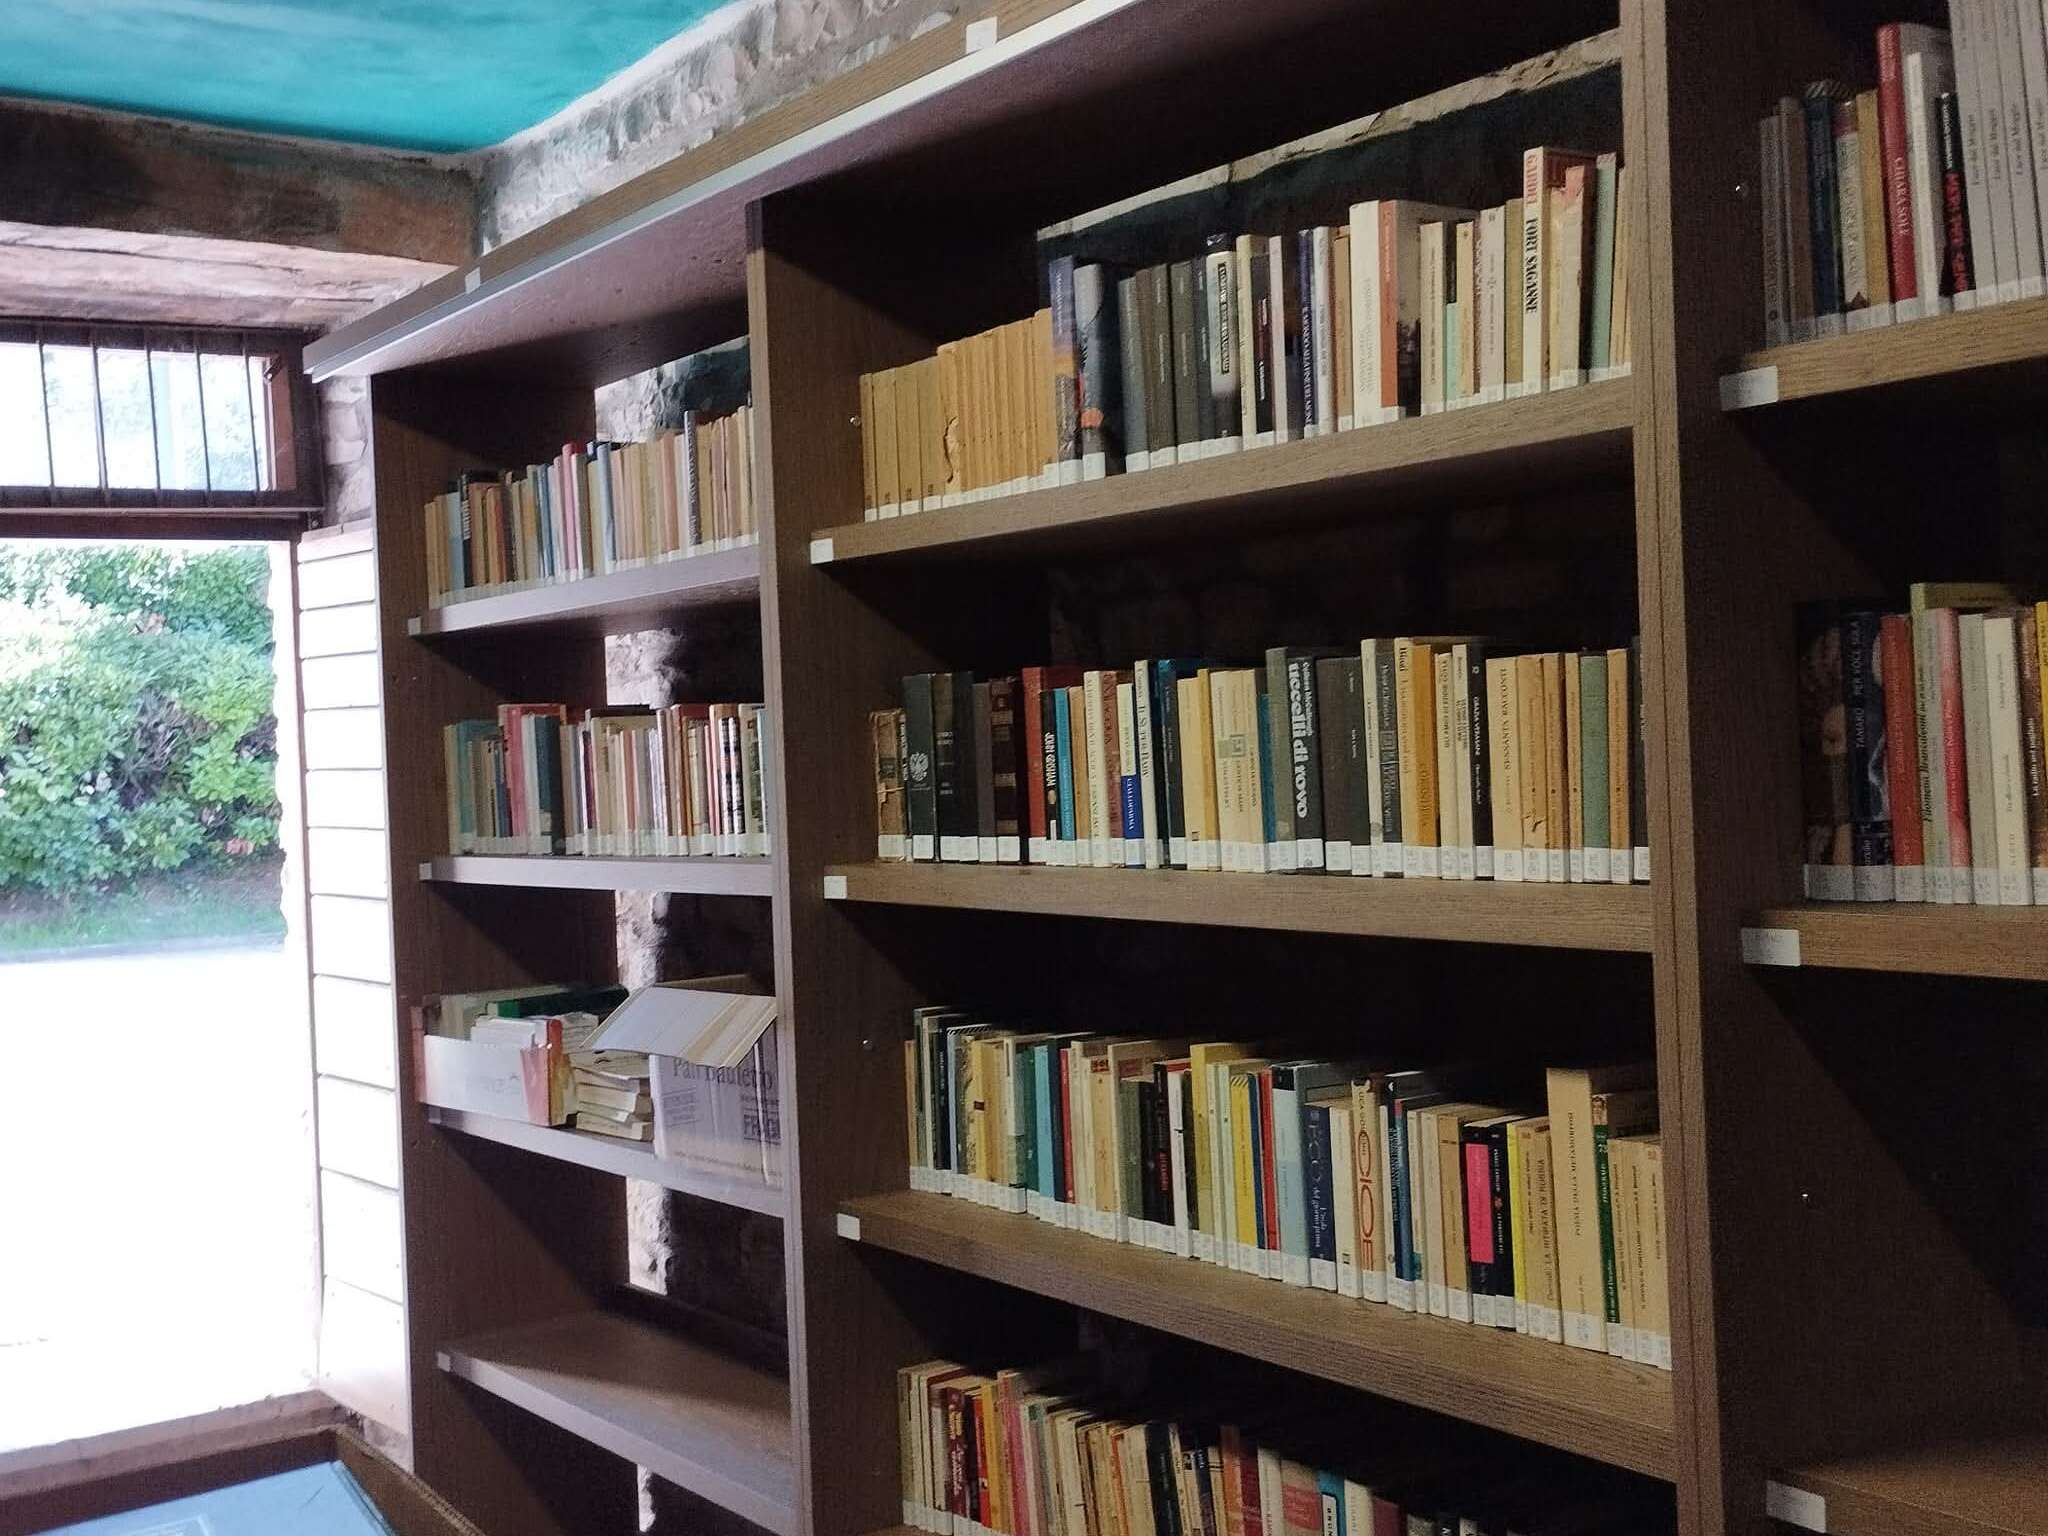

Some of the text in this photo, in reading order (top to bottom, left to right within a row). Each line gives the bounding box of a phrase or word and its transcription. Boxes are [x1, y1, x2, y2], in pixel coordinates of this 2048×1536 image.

[1525, 217, 1539, 315] FORT SAGANNE
[1302, 661, 1314, 737] Colleen McCullough
[1473, 696, 1481, 722] GRAZIA
[1044, 732, 1057, 787] JOHN GRISHAM
[1288, 661, 1308, 819] uccelli di rovo
[1503, 719, 1511, 770] SESSANTA
[1568, 1112, 1577, 1172] METAMORFOSI
[1311, 1199, 1320, 1224] giorno
[1311, 1225, 1321, 1248] prima
